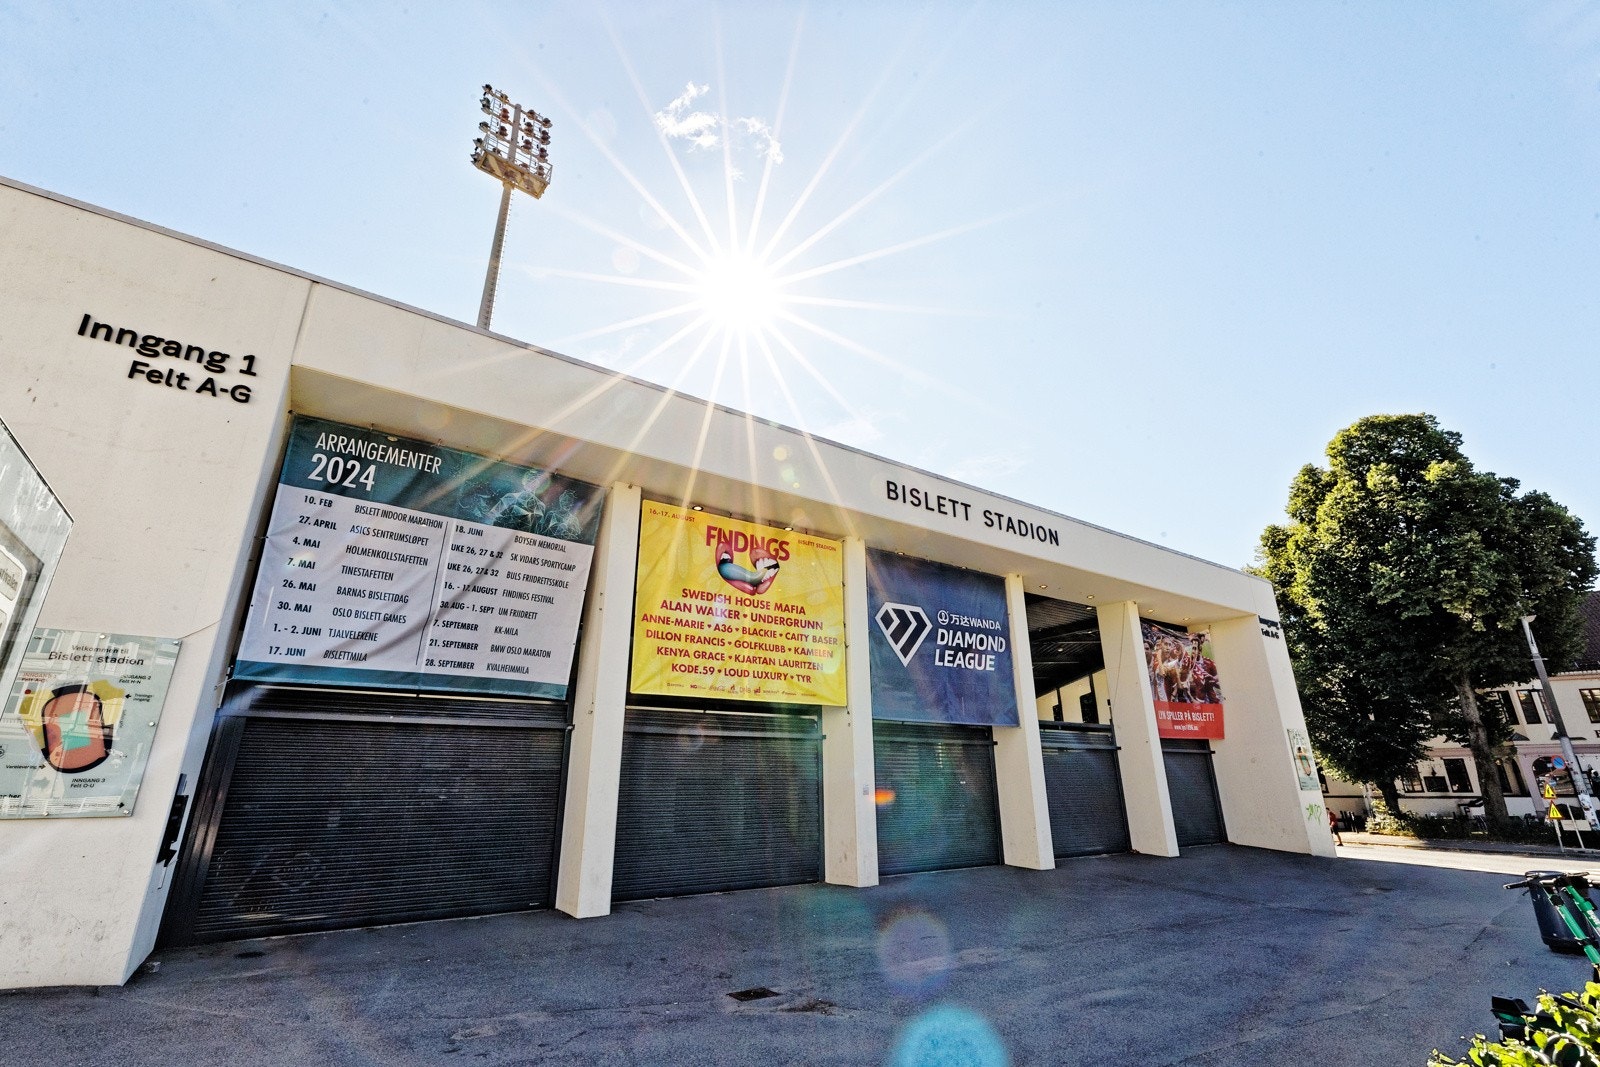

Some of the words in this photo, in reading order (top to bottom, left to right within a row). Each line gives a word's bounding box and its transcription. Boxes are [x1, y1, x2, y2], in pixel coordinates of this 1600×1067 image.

[78, 313, 229, 373] Inngang
[240, 354, 257, 376] 1
[128, 360, 190, 390] Felt
[196, 377, 252, 403] A-G
[315, 432, 442, 475] ARRANGEMENTER
[308, 454, 376, 491] 2024
[304, 496, 316, 505] 10.
[320, 499, 332, 507] FEB
[355, 505, 380, 517] BISLETT
[381, 511, 407, 521] INDOOR
[408, 515, 443, 529] MARATHON
[672, 512, 695, 522] AUGUST
[886, 481, 971, 521] BISLETT
[984, 510, 1059, 546] STADION
[299, 516, 311, 524] 27.
[314, 519, 337, 530] APRIL
[350, 525, 370, 535] ASICS
[372, 529, 429, 546] SENTRUMSLØPET
[455, 525, 465, 533] 18.
[515, 536, 537, 546] BOYSEN
[538, 540, 566, 552] MEMORIAL
[293, 537, 300, 545] 4.
[303, 538, 320, 548] MAI
[346, 545, 428, 566] HOLMENKOLLSTAFETTEN
[451, 544, 464, 552] UKE
[467, 546, 477, 555] 26,
[479, 548, 488, 556] 27
[511, 553, 518, 561] SK
[520, 555, 539, 565] VIDARS
[541, 559, 576, 571] SPORTYCAMP
[816, 541, 836, 551] STADION
[288, 558, 295, 567] 7.
[298, 560, 315, 569] MAI
[342, 565, 393, 581] TINESTAFETTEN
[448, 563, 460, 571] UKE
[463, 565, 473, 574] 26,
[507, 571, 521, 581] BULS
[522, 574, 569, 589] FRIIDRETTSSKOLE
[283, 580, 296, 589] 26.
[299, 581, 316, 591] MAI
[337, 587, 366, 598] BARNAS
[368, 592, 409, 604] BISLETTDAG
[444, 582, 455, 590] 16.
[472, 586, 498, 595] AUGUST
[503, 589, 530, 600] FINDINGS
[531, 593, 554, 604] FESTIVAL
[682, 588, 731, 604] SWEDISH
[735, 596, 770, 610] HOUSE
[774, 602, 806, 615] MAFIA
[278, 601, 291, 610] 30.
[294, 604, 311, 613] MAI
[332, 608, 352, 618] OSLO
[354, 610, 381, 621] BISLETT
[383, 613, 406, 623] GAMES
[450, 602, 465, 610] AUG
[480, 606, 494, 614] SEPT
[498, 608, 508, 616] UM
[510, 609, 538, 620] FRIIDRETT
[661, 600, 692, 613] ALAN
[696, 605, 740, 620] WALKER
[750, 614, 823, 630] UNDERGRUNN
[273, 624, 281, 632] 1.
[291, 626, 298, 634] 2.
[301, 627, 321, 636] JUNI
[329, 629, 378, 641] TJALVELEKENE
[433, 619, 439, 627] 7.
[442, 621, 478, 631] SEPTEMBER
[494, 626, 519, 636] KK-MILA
[642, 614, 704, 629] ANNE-MARIE
[714, 624, 732, 633] A36
[742, 627, 777, 638] BLACKIE
[785, 632, 808, 642] CAITY
[812, 636, 838, 645] BASER
[429, 639, 439, 647] 21.
[442, 641, 478, 650] SEPTEMBER
[490, 644, 505, 653] BMW
[507, 646, 521, 655] OSLO
[523, 648, 551, 658] MARATON
[646, 630, 681, 642] DILLON
[685, 634, 725, 646] FRANCIS
[734, 641, 785, 653] GOLFKLUBB
[794, 647, 833, 658] KAMELEN
[937, 629, 1006, 652] DIAMOND
[48, 651, 91, 662] Bislett
[97, 656, 144, 665] stadion
[268, 646, 281, 655] 17.
[285, 648, 306, 656] JUNI
[323, 650, 367, 661] BISLETTMILA
[657, 646, 690, 657] KENYA
[694, 650, 725, 661] GRACE
[735, 655, 775, 666] KJARTAN
[779, 659, 823, 670] LAURITZEN
[935, 650, 995, 671] LEAGUE
[425, 659, 435, 667] 28.
[438, 660, 474, 670] SEPTEMBER
[486, 663, 529, 674] KVALHEIMMILA
[672, 663, 714, 675] KODE.59
[724, 668, 749, 677] LOUD
[753, 671, 787, 680] LUXURY
[796, 674, 811, 683] TYR
